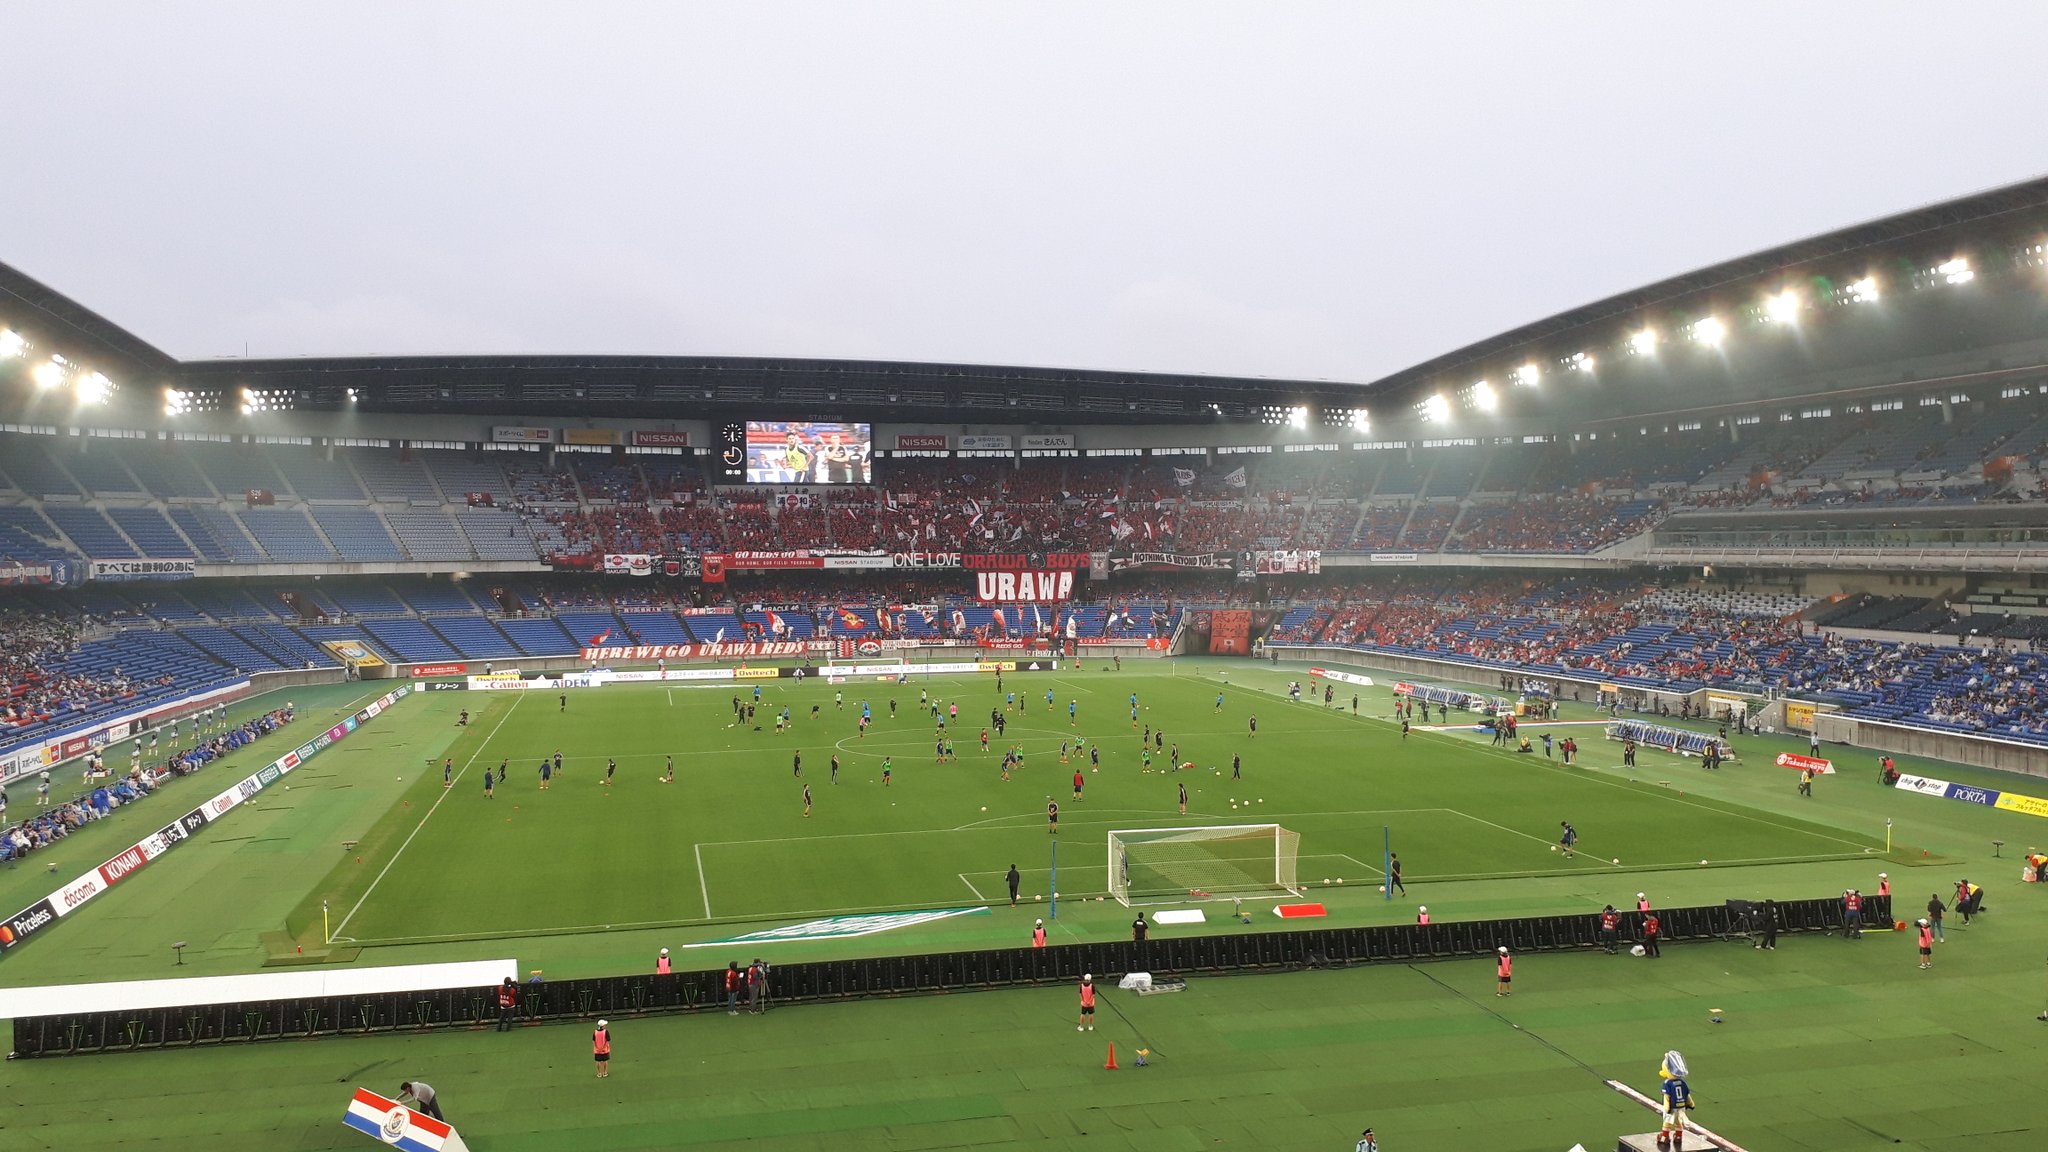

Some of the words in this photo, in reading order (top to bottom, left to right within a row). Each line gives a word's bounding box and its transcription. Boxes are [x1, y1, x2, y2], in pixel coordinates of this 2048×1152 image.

[640, 434, 684, 443] NISSAN
[901, 438, 943, 446] NISSAN
[735, 551, 750, 559] GO
[894, 553, 924, 567] ONE
[928, 552, 961, 567] LOVE
[963, 554, 1028, 568] URAWA
[1046, 553, 1090, 568] BOYS
[1133, 552, 1165, 562] NOTHING
[1165, 554, 1172, 563] IS
[1172, 555, 1198, 566] BEYOND
[1198, 555, 1213, 567] YOU
[978, 571, 1073, 601] URAWA
[585, 645, 636, 660] HERE
[636, 645, 664, 658] WE
[665, 645, 692, 658] GO
[698, 643, 757, 657] URAWA
[759, 641, 804, 655] REDS
[489, 681, 529, 689] Canon
[68, 741, 85, 753] NISSAN
[1901, 777, 1914, 786] chip
[1927, 782, 1942, 791] stop
[1953, 788, 1987, 804] PORTA
[212, 795, 234, 814] Canon
[104, 849, 142, 880] KONAMI
[64, 882, 97, 908] docomo
[13, 908, 53, 936] Priceless
[1675, 1086, 1683, 1099] 0
